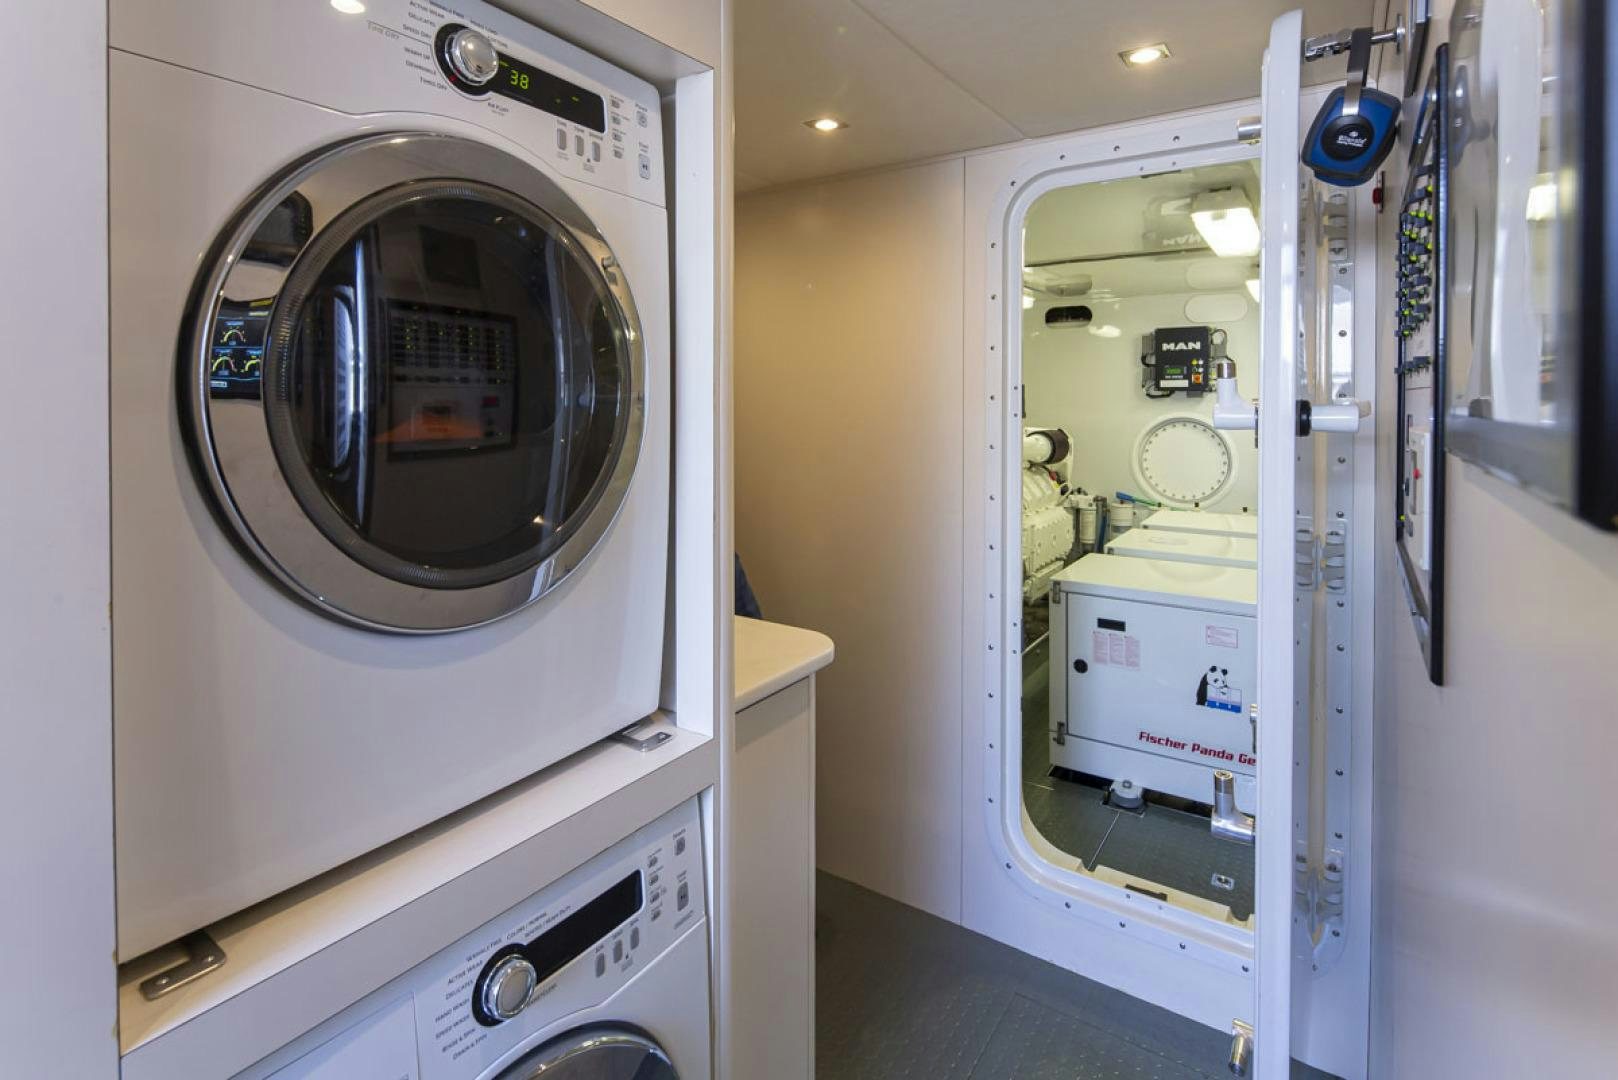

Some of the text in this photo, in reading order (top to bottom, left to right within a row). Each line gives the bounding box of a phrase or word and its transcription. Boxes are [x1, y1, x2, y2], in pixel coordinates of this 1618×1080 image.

[510, 69, 529, 90] 38
[1162, 341, 1201, 352] MAN
[1138, 731, 1188, 750] Fischer
[1191, 742, 1235, 762] Panda
